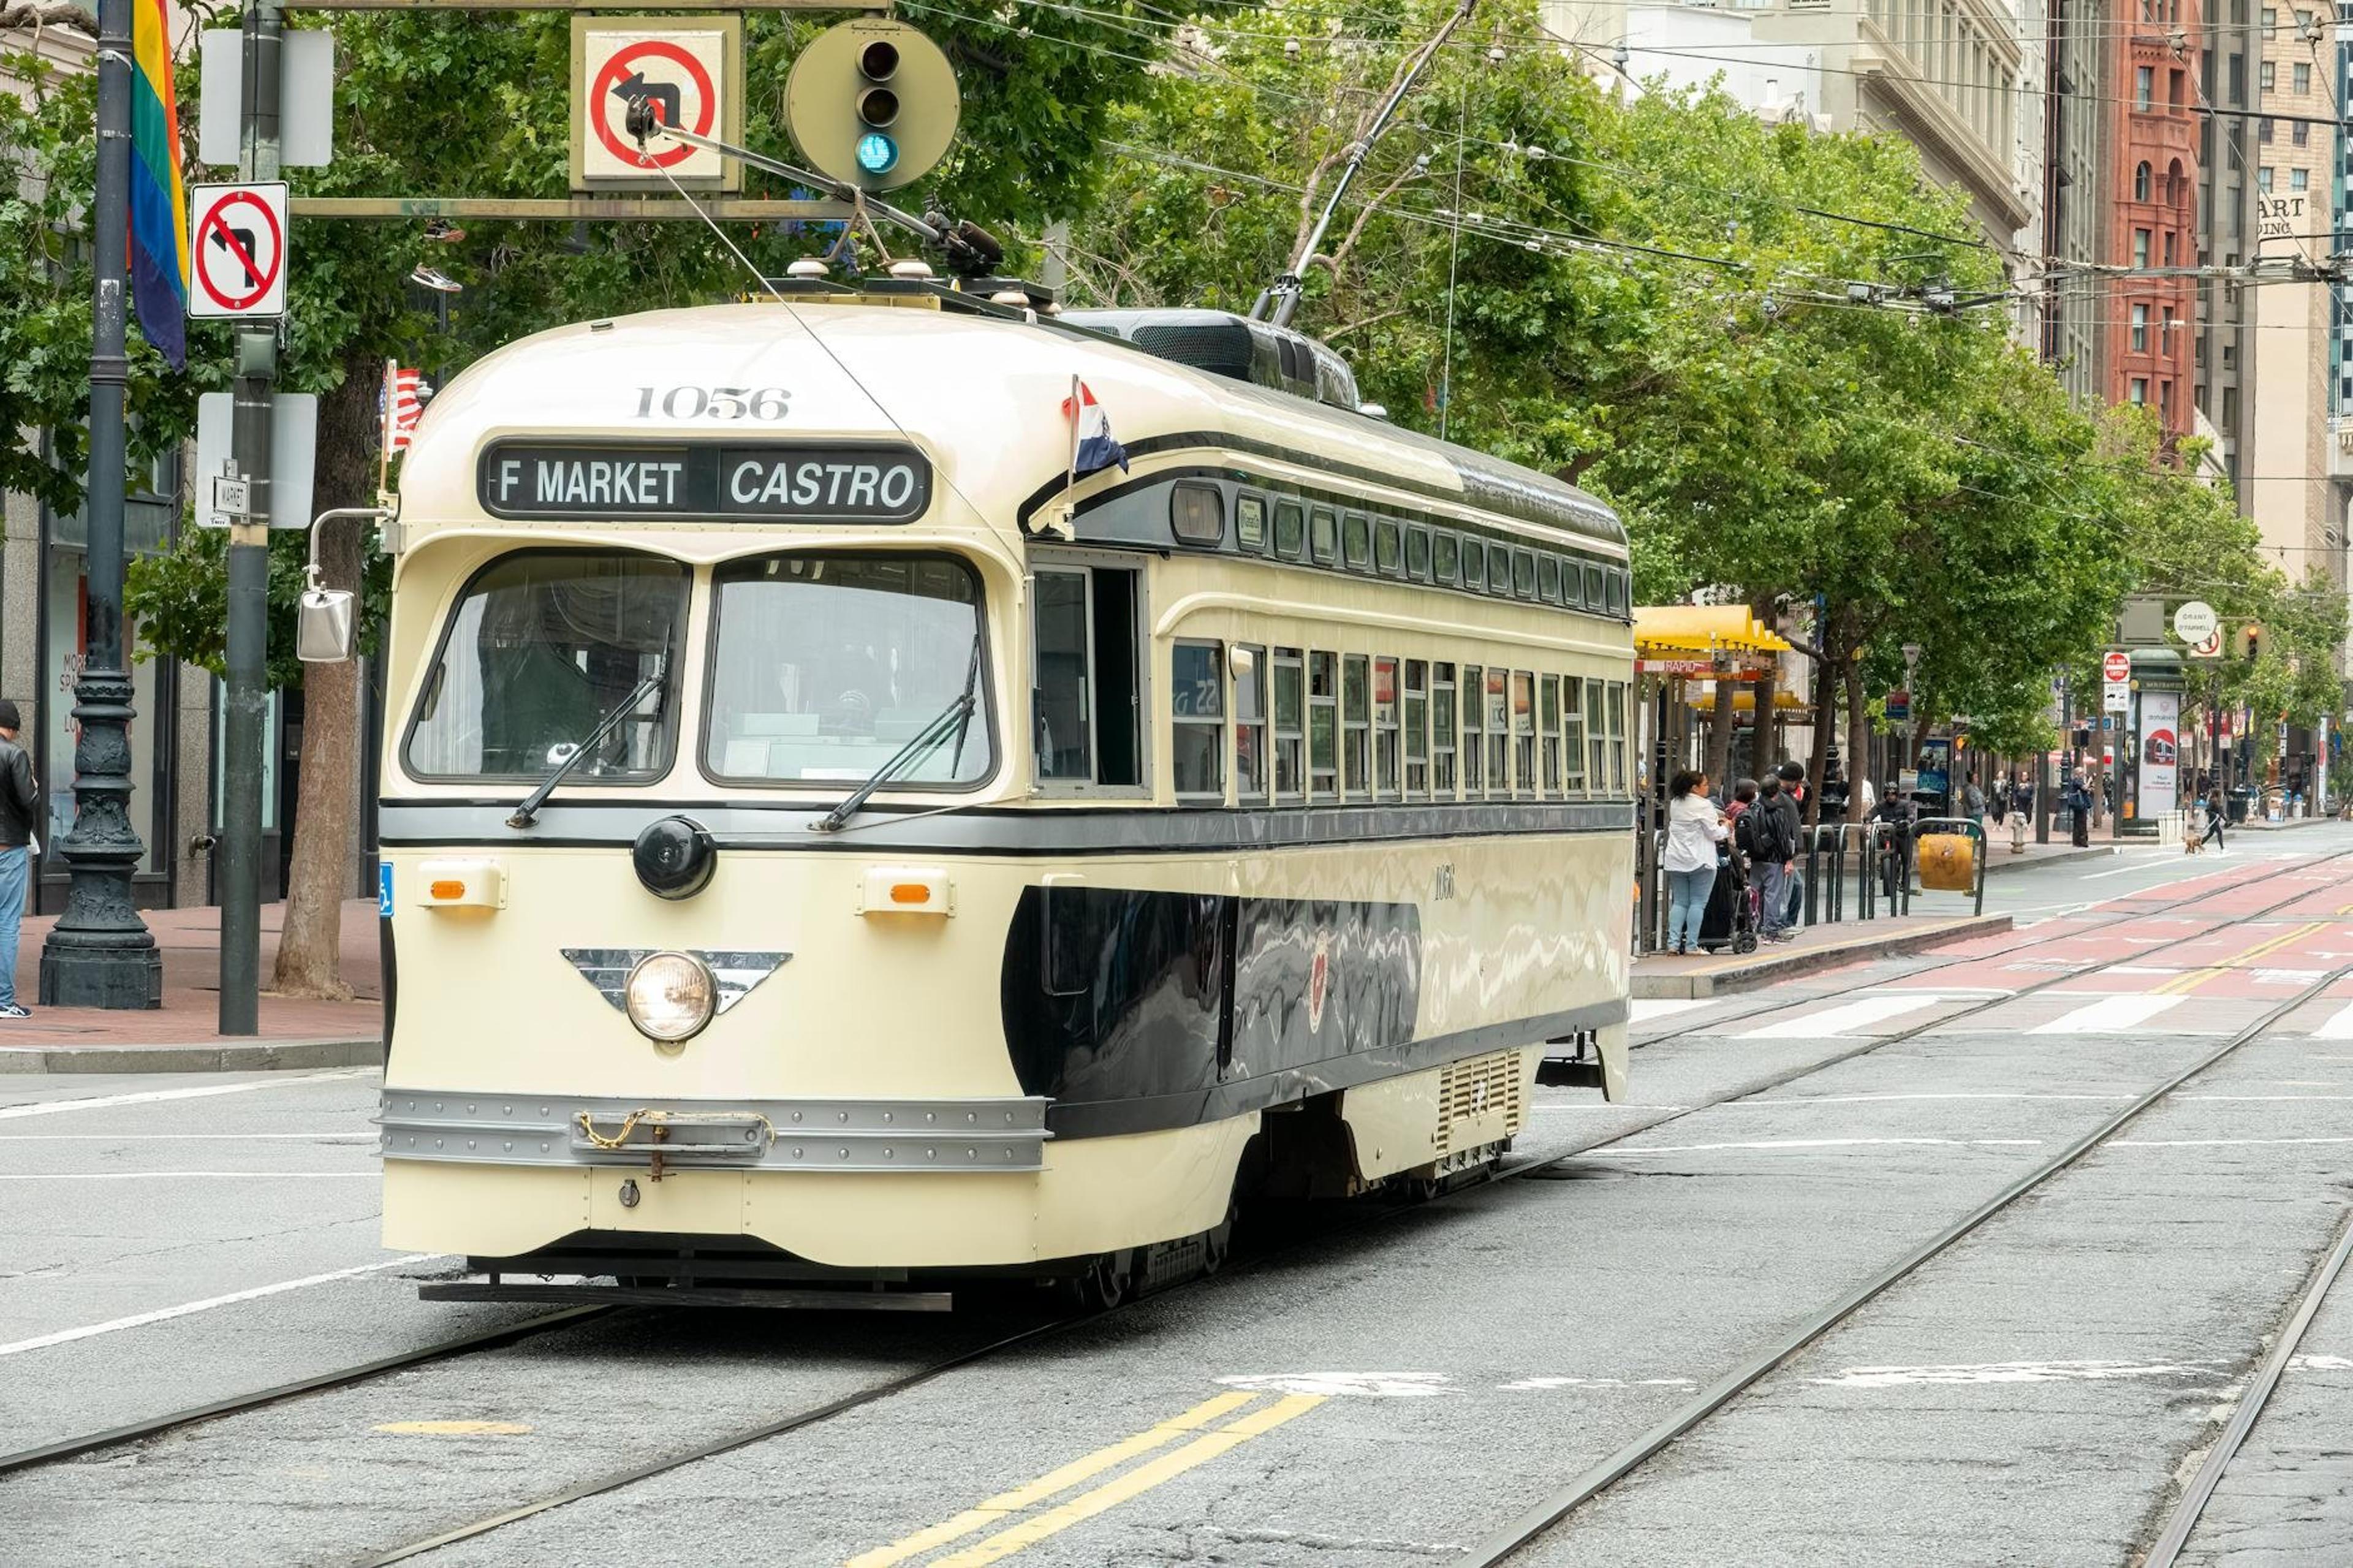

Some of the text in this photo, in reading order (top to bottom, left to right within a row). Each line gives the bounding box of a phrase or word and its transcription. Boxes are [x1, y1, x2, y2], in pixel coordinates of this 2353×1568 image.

[633, 386, 792, 420] 1056
[501, 461, 681, 504] F MARKET
[731, 461, 914, 508] CASTRO
[1665, 661, 1696, 673] RAPID
